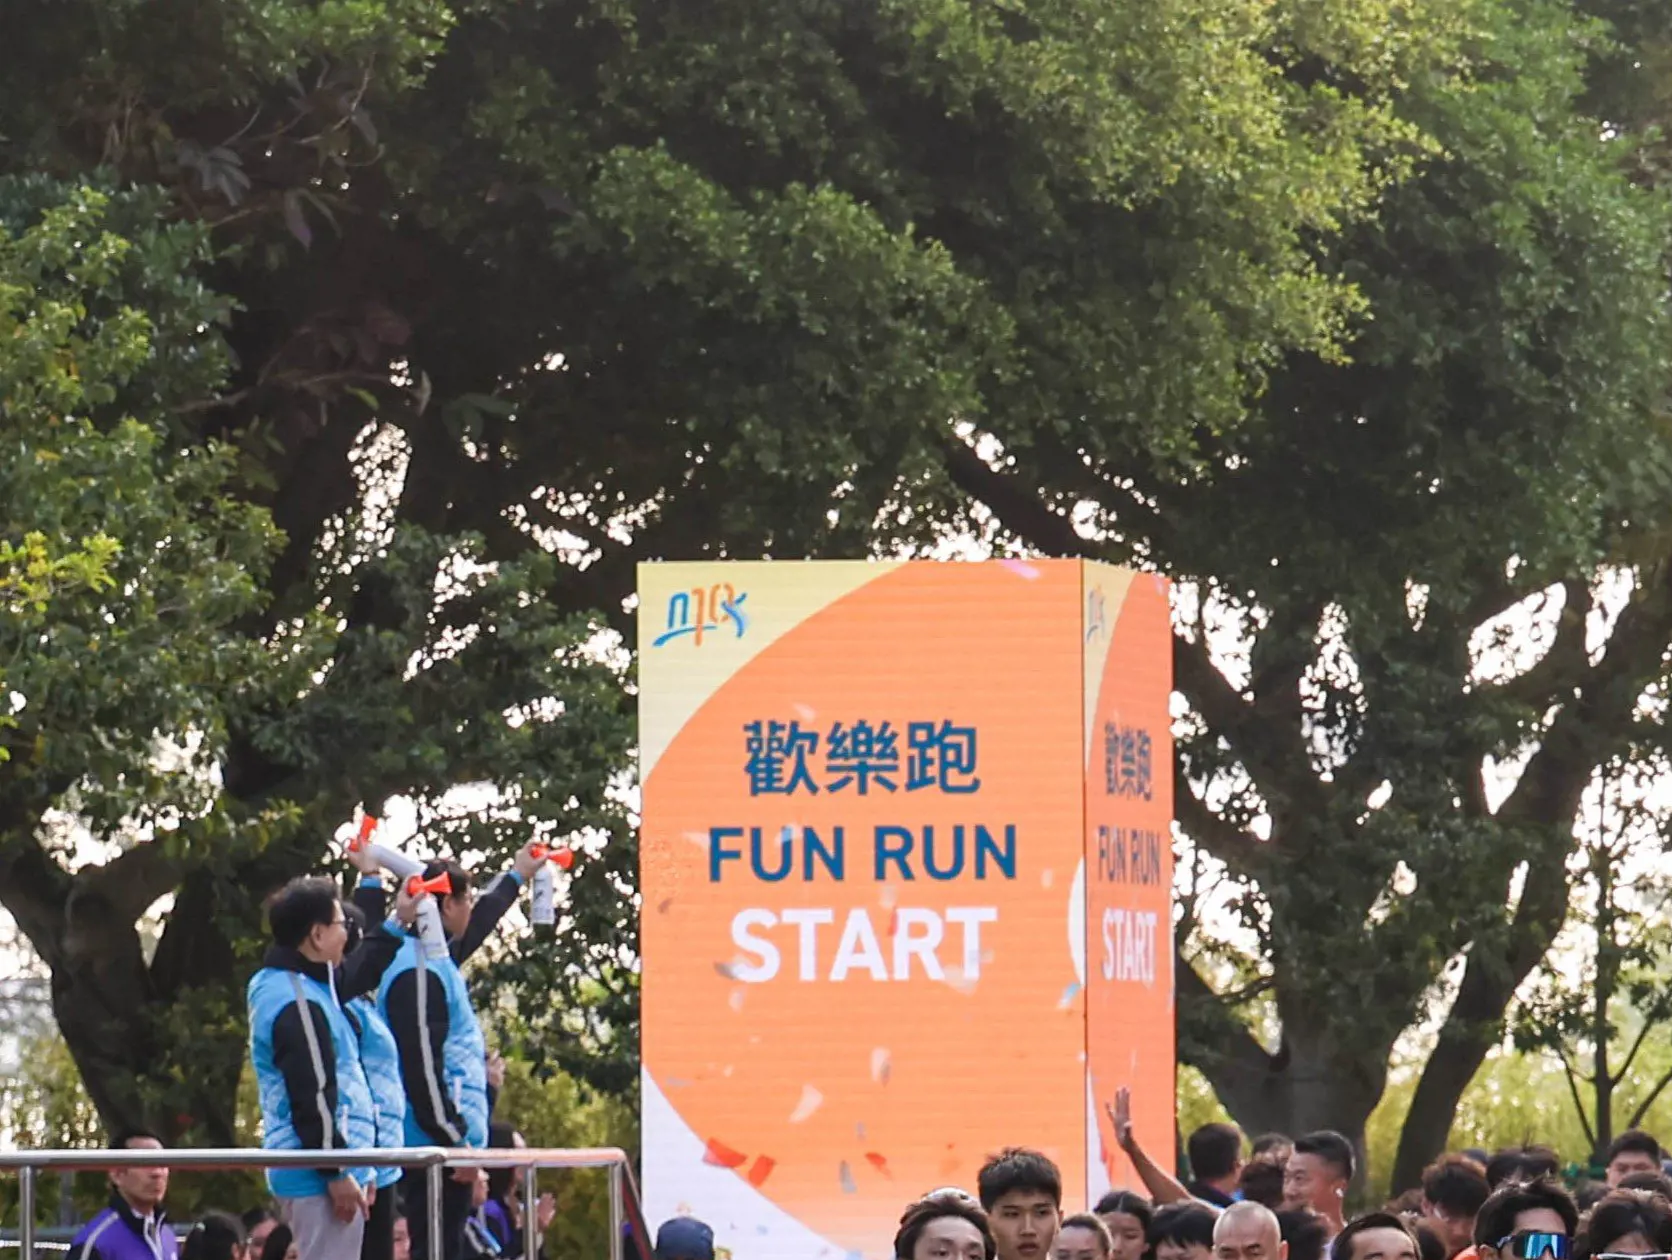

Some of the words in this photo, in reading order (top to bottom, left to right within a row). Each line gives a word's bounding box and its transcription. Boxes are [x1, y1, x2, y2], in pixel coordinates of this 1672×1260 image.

[743, 720, 981, 797] 歡樂跑
[708, 827, 845, 882] FUN
[875, 824, 1017, 880] RUN
[1099, 825, 1126, 882] FUN
[1131, 829, 1160, 886] RUN
[731, 907, 997, 983] START
[1103, 907, 1157, 981] START
